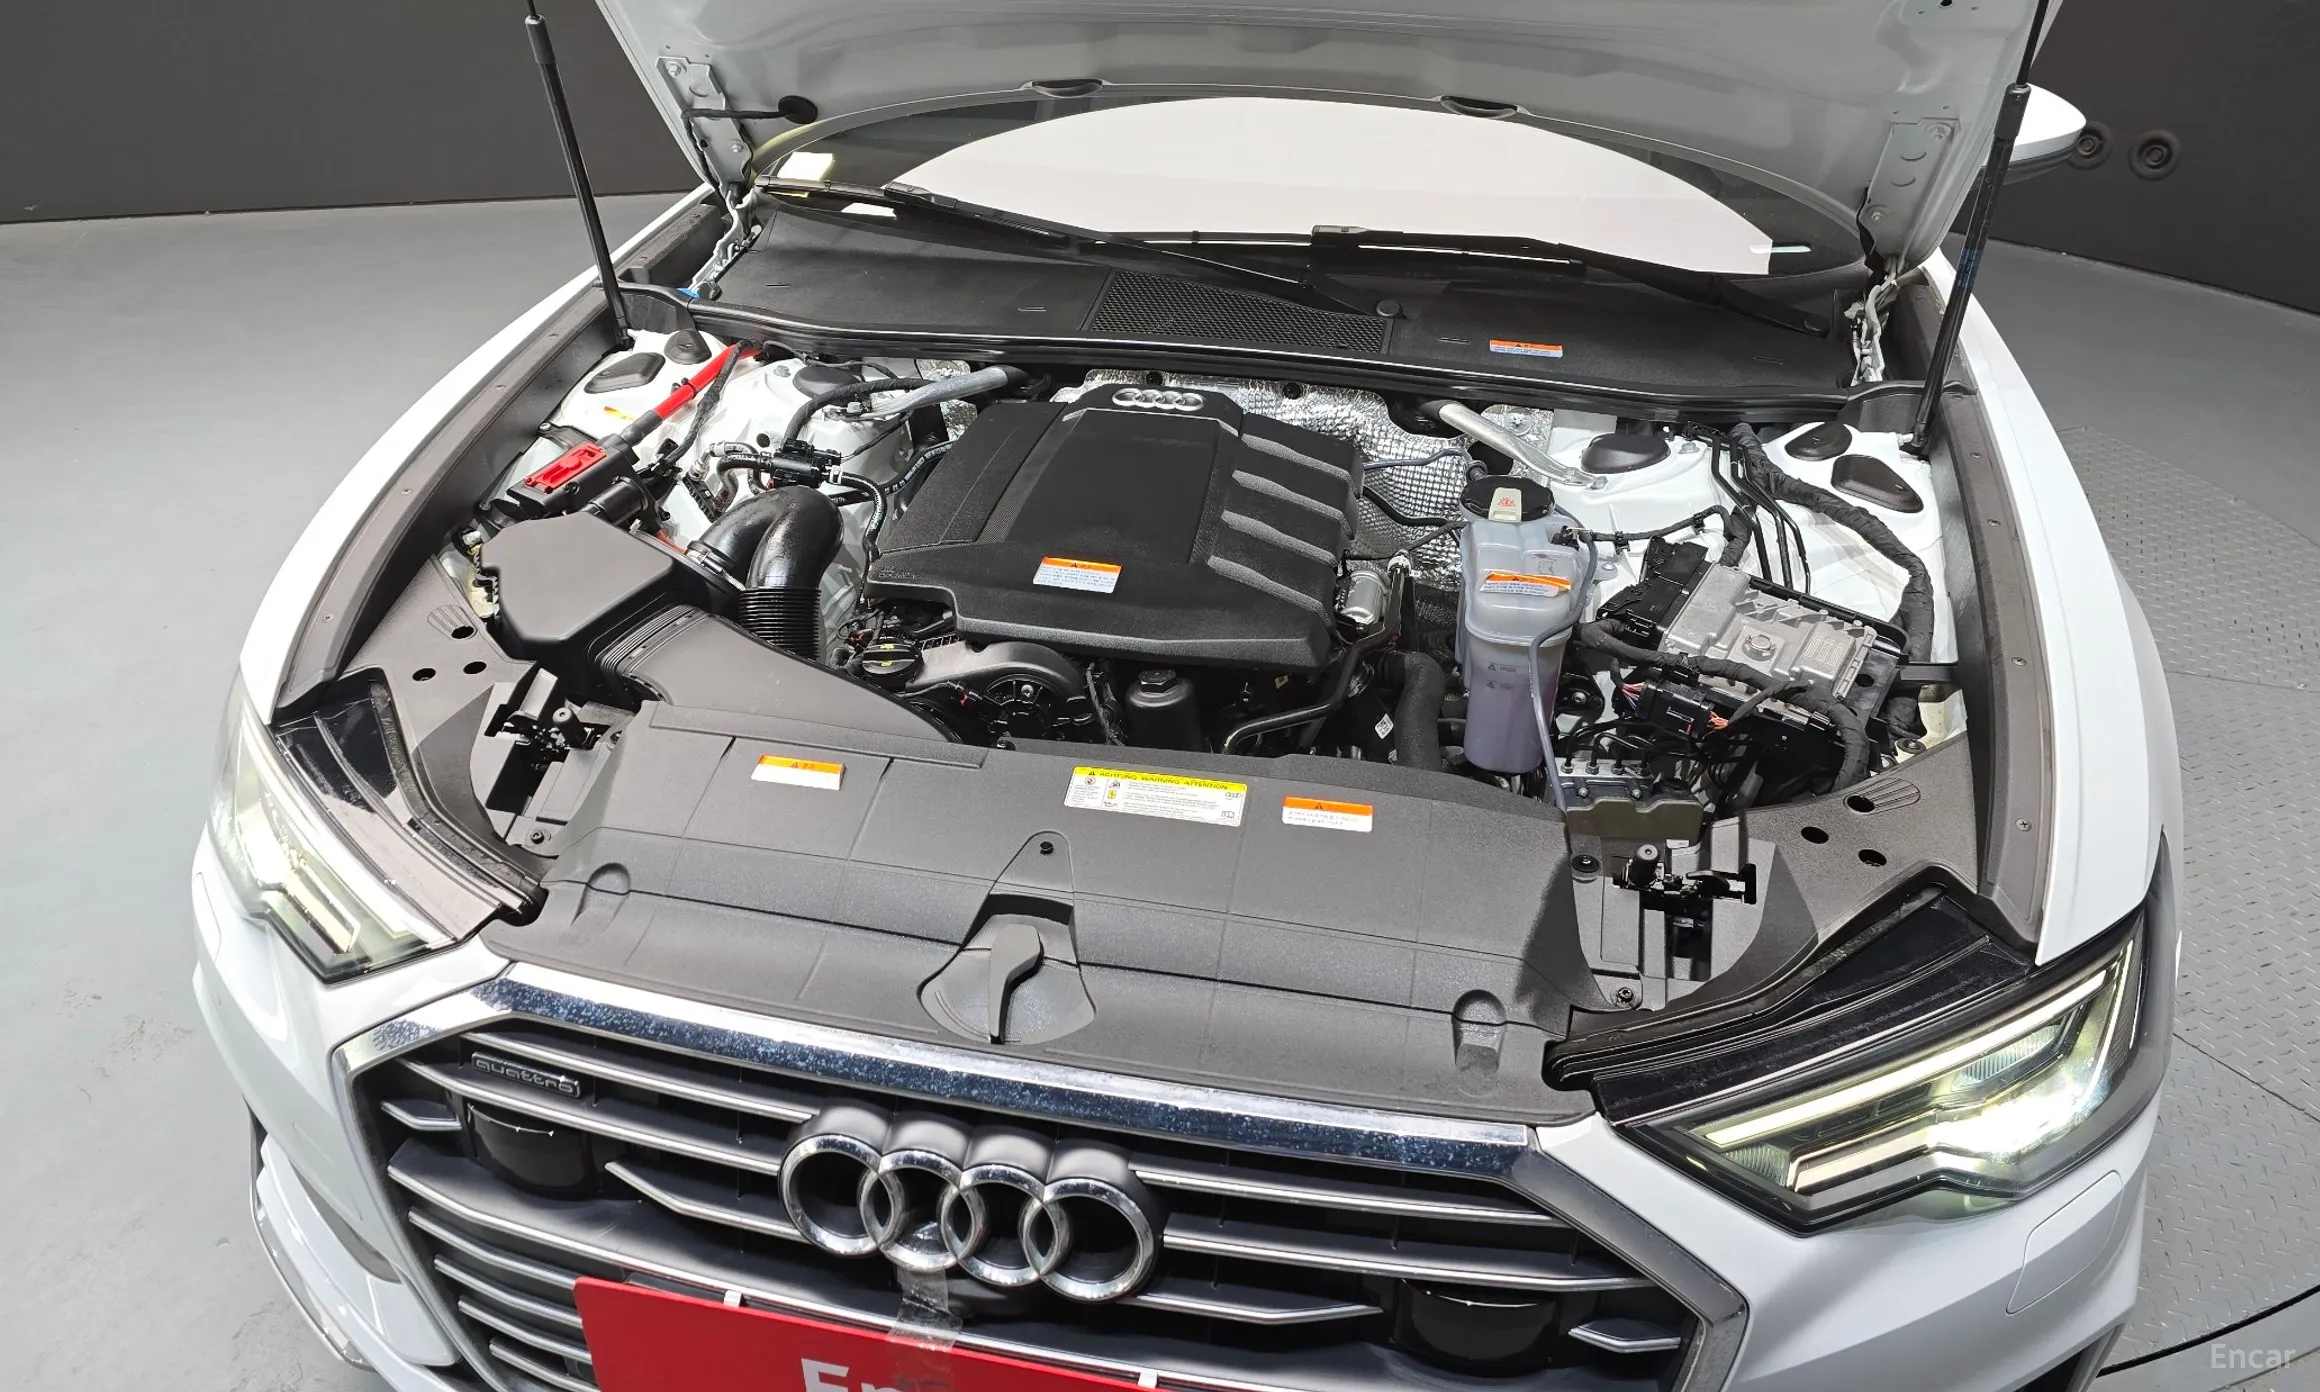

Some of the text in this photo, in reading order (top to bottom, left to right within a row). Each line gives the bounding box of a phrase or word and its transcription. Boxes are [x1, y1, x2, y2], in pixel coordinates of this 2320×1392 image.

[1100, 772, 1228, 790] ACHTUNG WARNING ATTENTION
[476, 1059, 573, 1093] quattro
[801, 1358, 903, 1392] E
